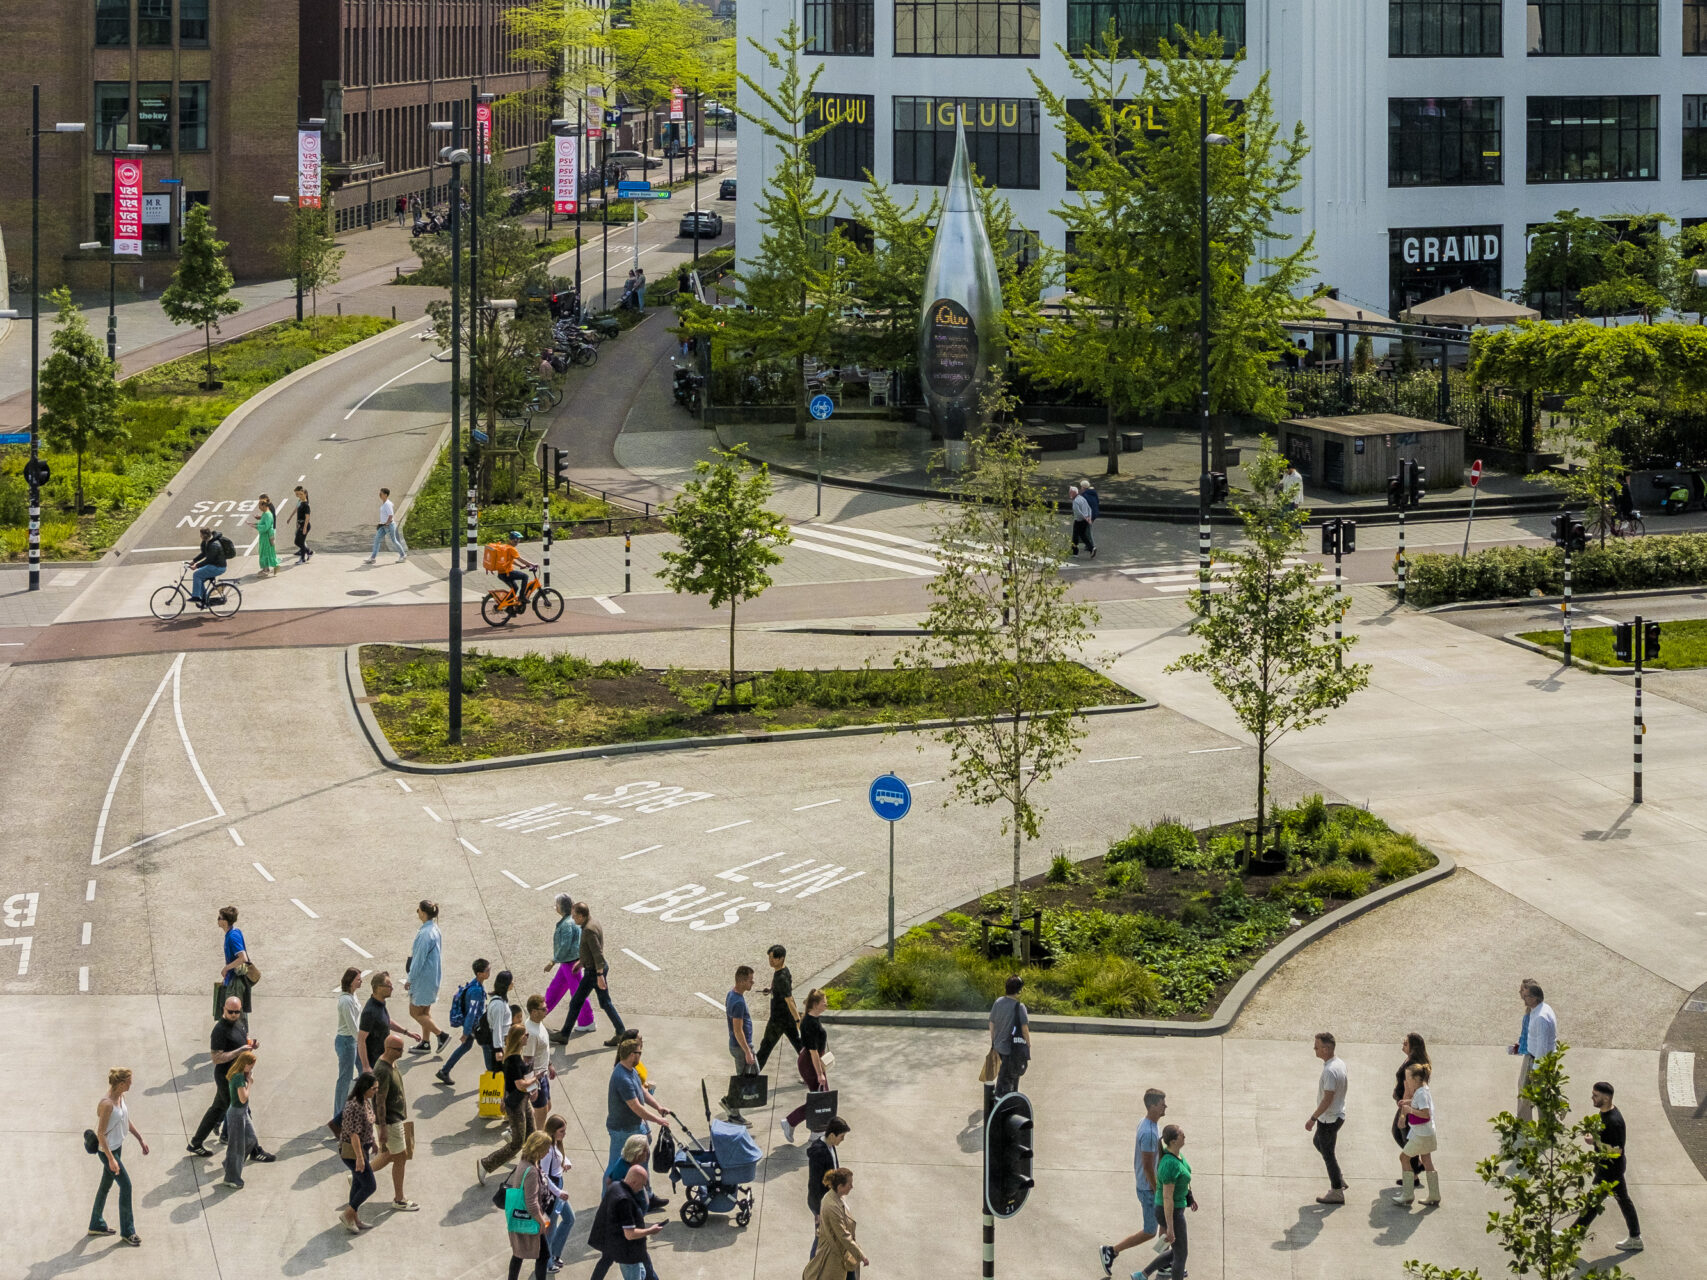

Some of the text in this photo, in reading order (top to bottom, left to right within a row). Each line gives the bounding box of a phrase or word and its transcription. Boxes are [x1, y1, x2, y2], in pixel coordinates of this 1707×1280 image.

[820, 97, 866, 124] IGLUU
[926, 101, 1017, 127] IGLUU
[1403, 234, 1499, 264] GRAND
[190, 500, 259, 513] BUS
[582, 780, 715, 813] BUS
[479, 802, 624, 840] LIJN
[714, 852, 867, 898] LIJN
[620, 883, 772, 931] BUS
